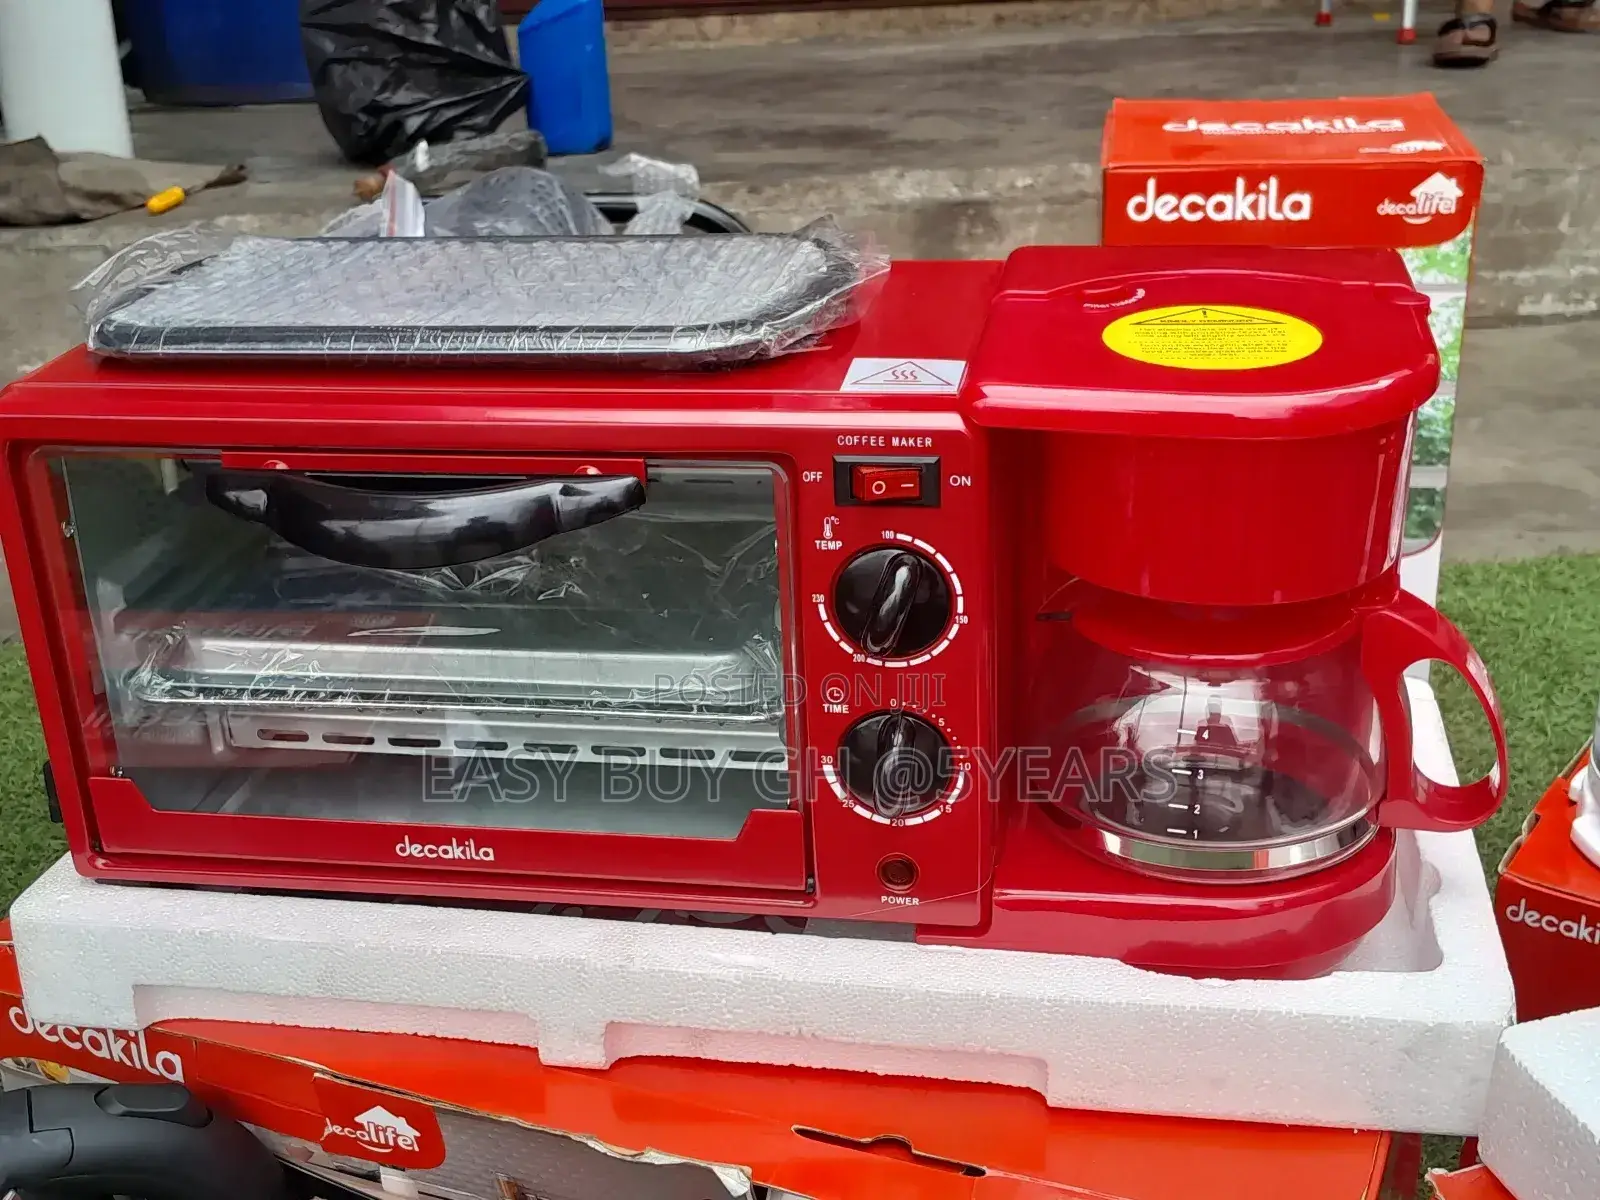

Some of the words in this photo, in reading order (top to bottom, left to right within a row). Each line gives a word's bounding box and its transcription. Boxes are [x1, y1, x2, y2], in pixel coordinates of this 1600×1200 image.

[1126, 176, 1312, 222] decakila
[1376, 191, 1457, 216] decalife
[837, 435, 885, 447] COFFEE
[891, 436, 932, 448] MAKER
[802, 470, 823, 482] OFF
[949, 475, 971, 487] ON
[881, 530, 895, 540] 100
[814, 540, 843, 550] TEMP
[811, 593, 825, 603] 230
[954, 614, 969, 624] 150
[852, 653, 866, 664] 200
[822, 703, 850, 714] TIME
[890, 698, 897, 708] 0
[938, 717, 946, 727] 5
[1201, 729, 1209, 740] 4
[820, 755, 834, 765] 30
[958, 762, 972, 772] 10
[1197, 769, 1204, 780] 3
[841, 800, 855, 809] 25
[939, 804, 953, 814] 15
[1193, 804, 1201, 815] 2
[890, 818, 905, 828] 20
[1192, 829, 1199, 840] 1
[395, 834, 495, 861] decakila
[880, 895, 920, 906] POWER
